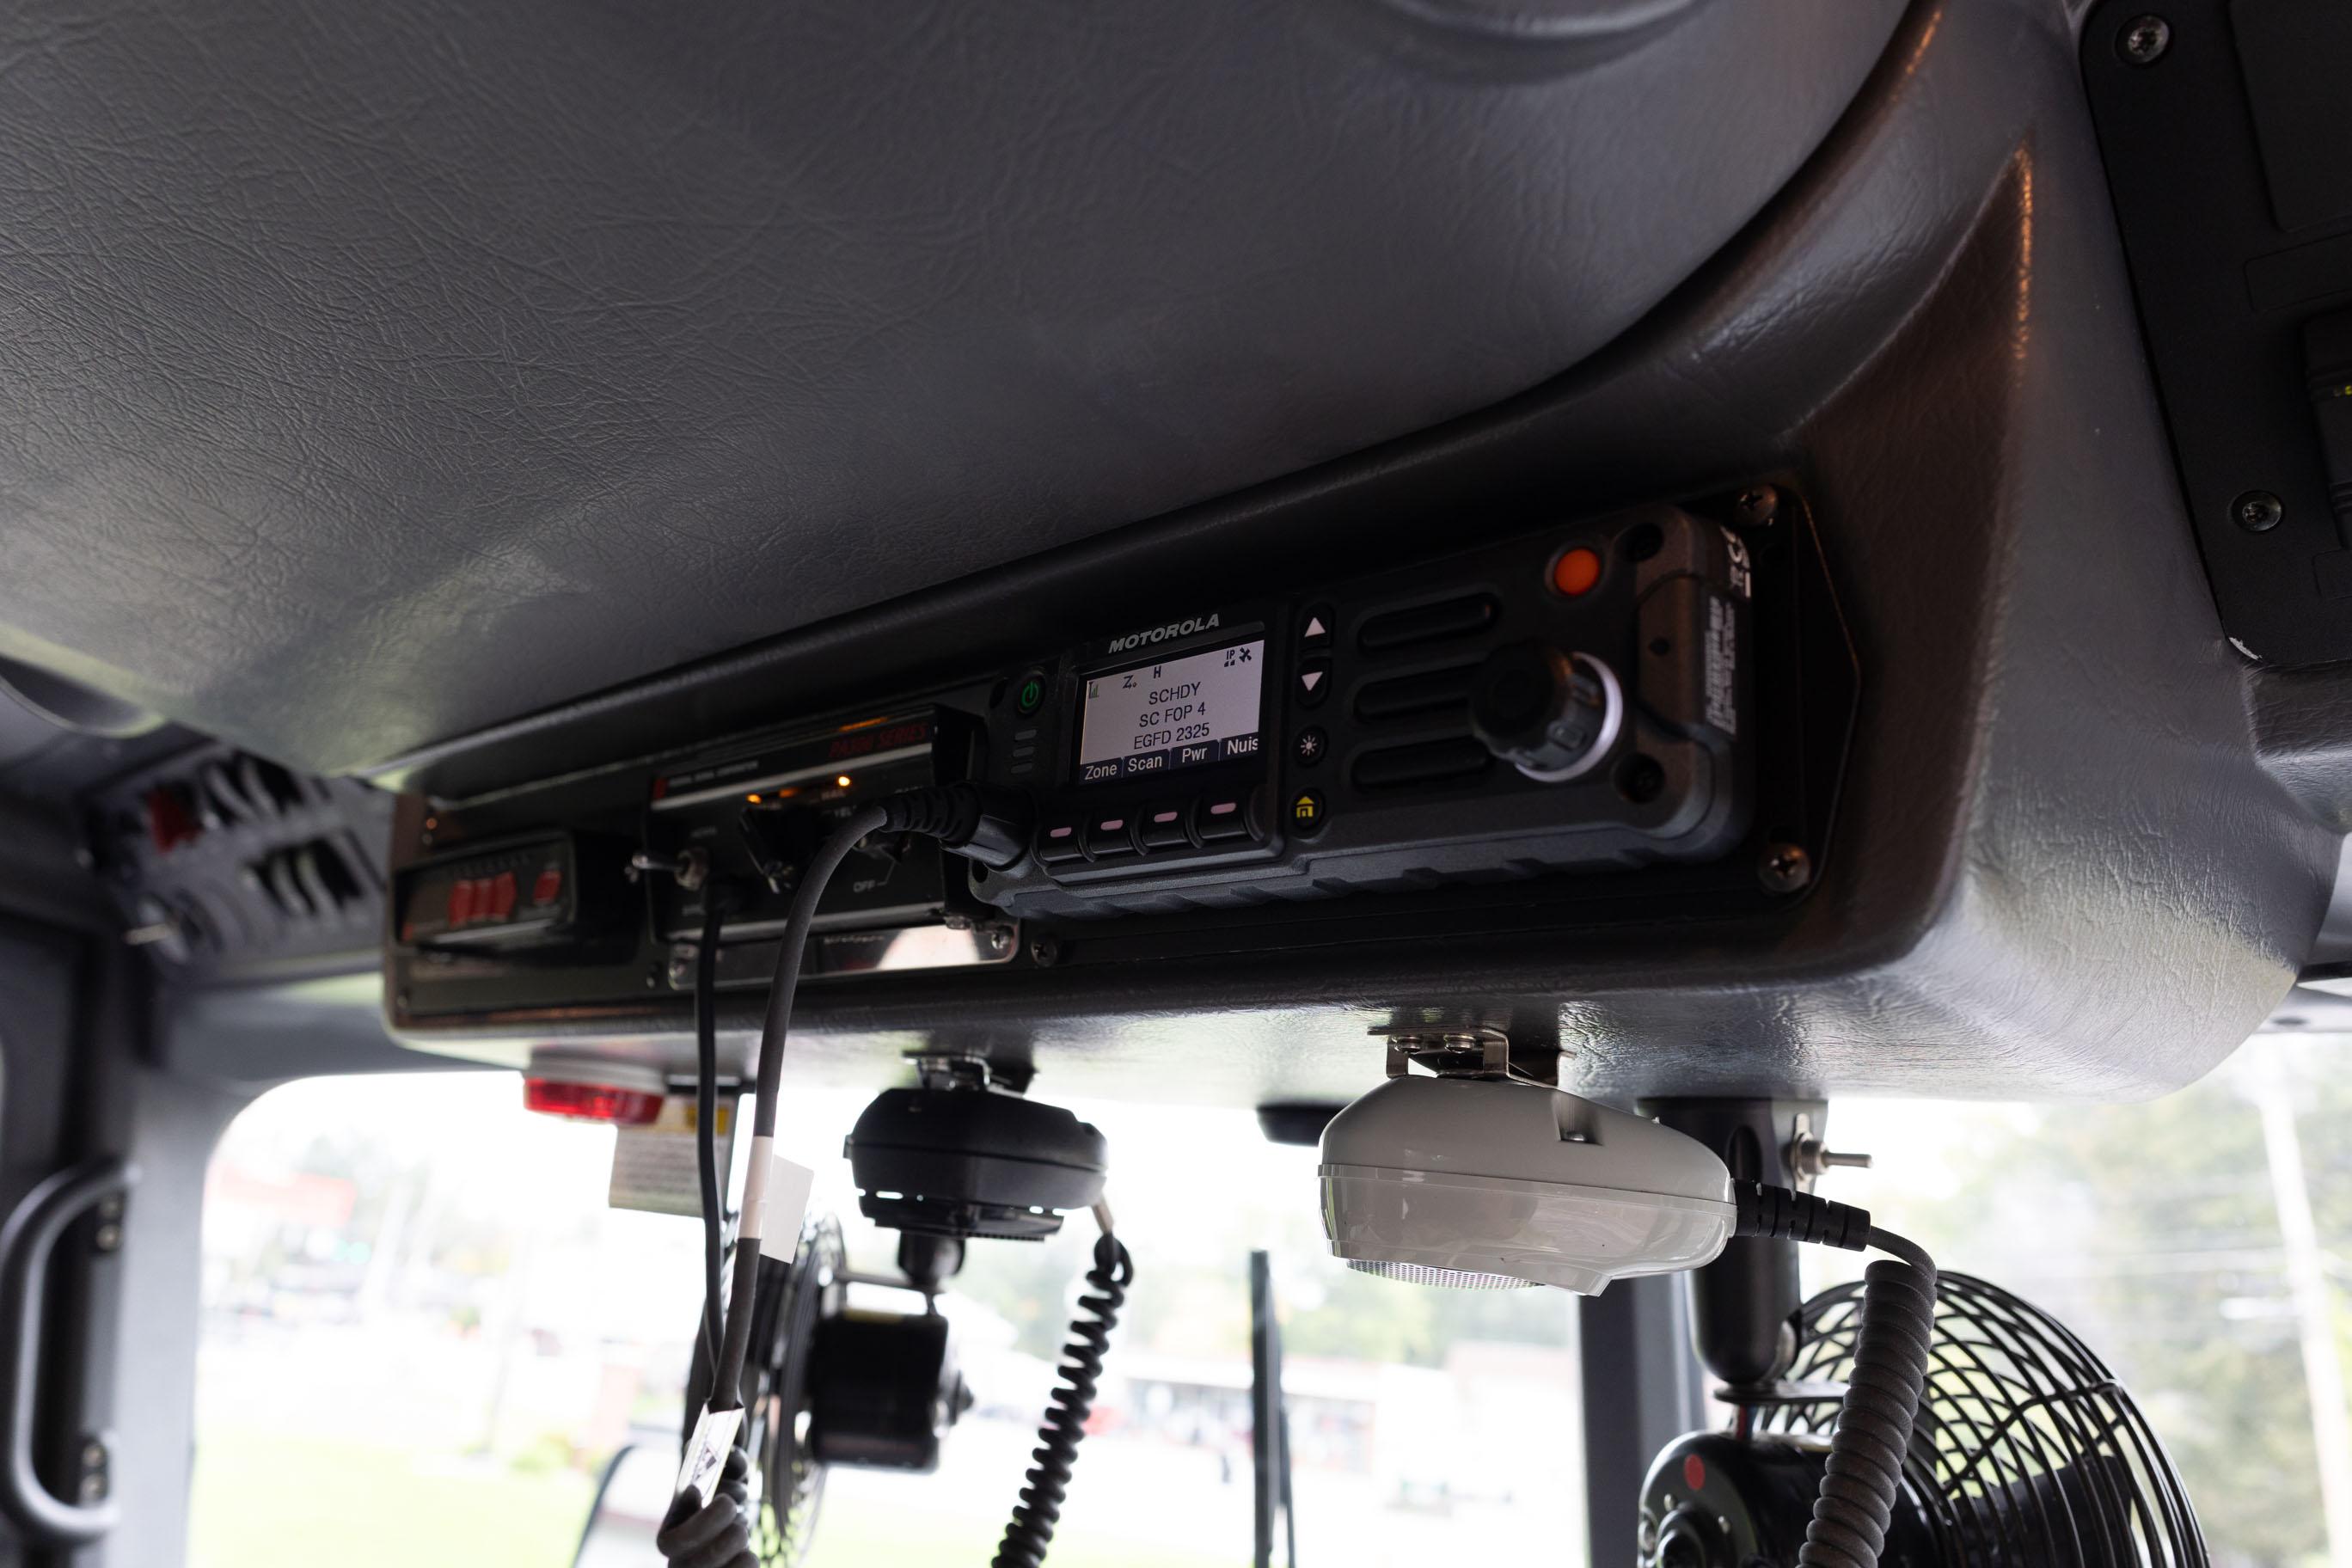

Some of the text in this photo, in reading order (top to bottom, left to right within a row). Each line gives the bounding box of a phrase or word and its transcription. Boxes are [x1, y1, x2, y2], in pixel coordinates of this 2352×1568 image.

[1108, 613, 1220, 654] MOTOROLA
[1153, 665, 1161, 678] H
[1148, 682, 1202, 705] SCHDY
[1139, 701, 1206, 728] SC FOP 4
[1134, 722, 1210, 750] EGFD 2325
[1084, 737, 1259, 781] Zone Scan Pwr Nuis
